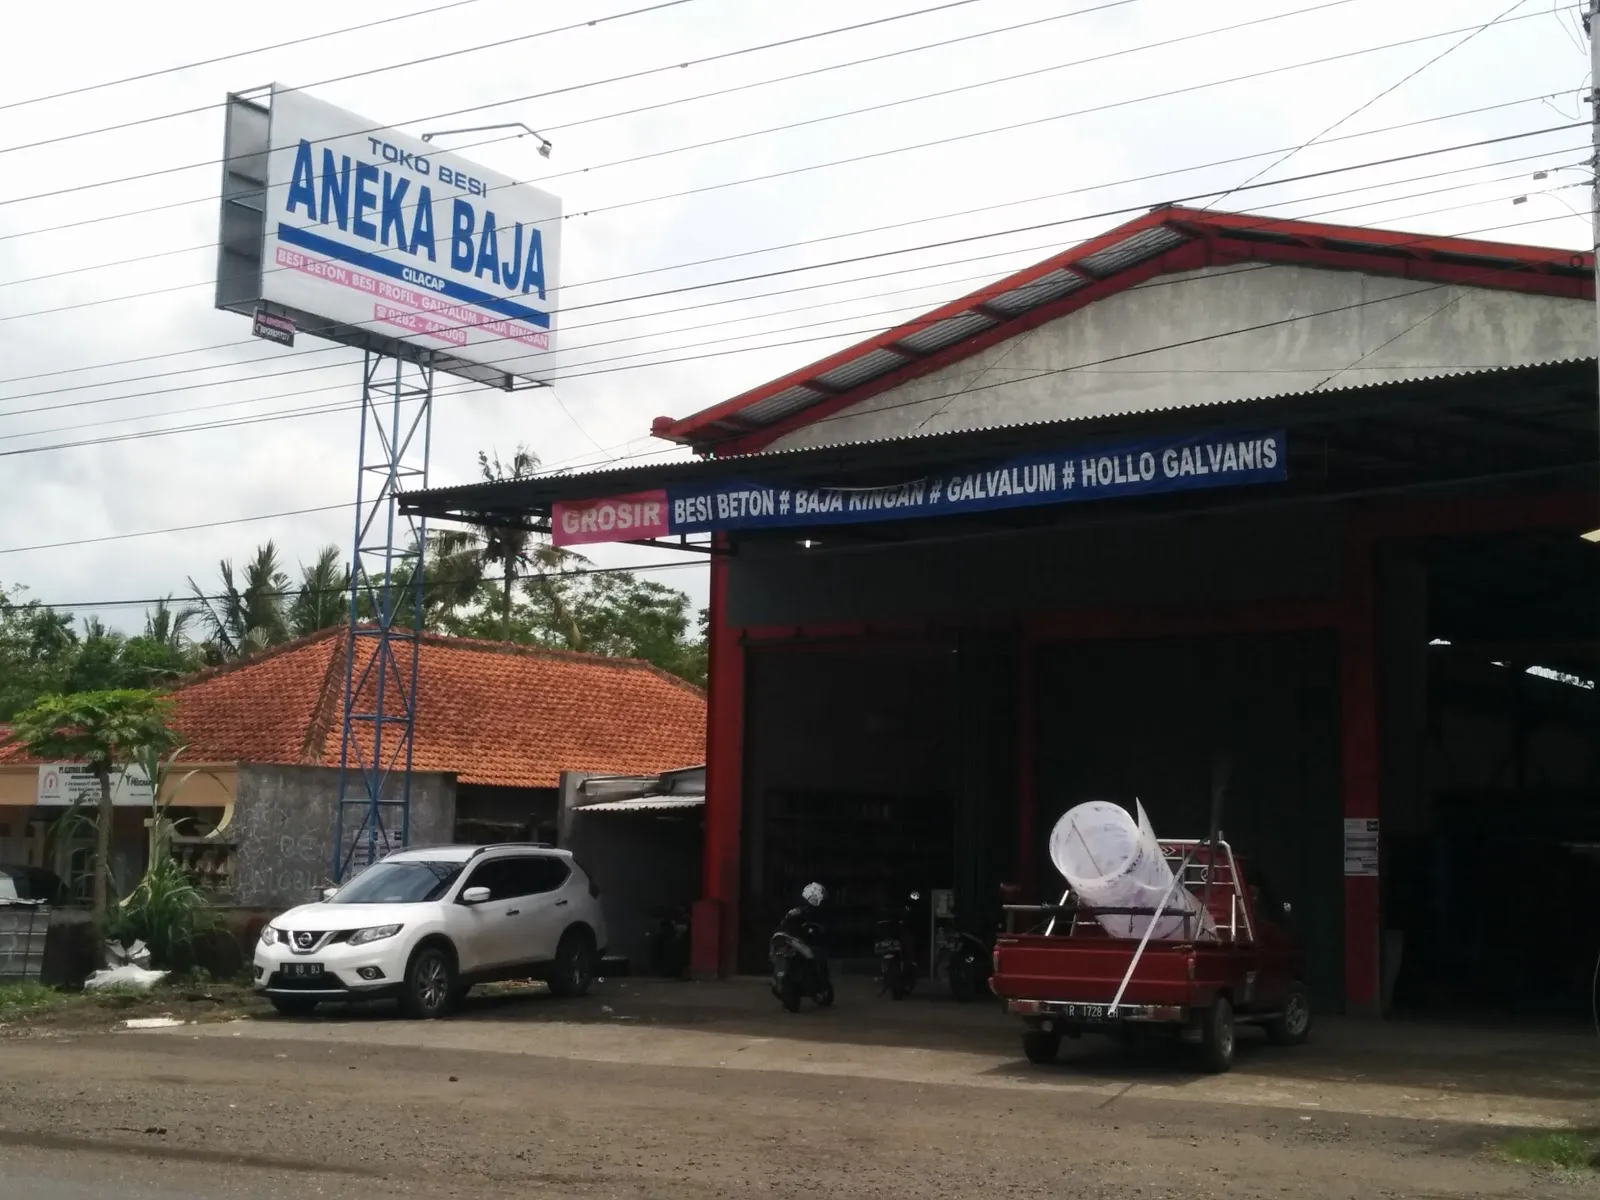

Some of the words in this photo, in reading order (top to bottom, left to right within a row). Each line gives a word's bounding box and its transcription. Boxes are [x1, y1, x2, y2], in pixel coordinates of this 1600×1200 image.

[368, 136, 430, 175] TOKO
[439, 158, 487, 198] BESI
[286, 138, 436, 262] ANEKA
[451, 198, 546, 300] BAJA
[278, 249, 303, 268] BESI
[352, 274, 376, 292] BESI
[509, 324, 548, 347] RINGAN
[402, 267, 446, 290] CILACAP
[561, 500, 662, 535] GROSIR
[674, 495, 713, 525] BESI
[717, 489, 775, 521] BETON
[795, 487, 843, 515] BAJA
[947, 462, 1056, 502] GALVALUM
[1081, 452, 1154, 487] HOLLO
[1163, 438, 1277, 478] GALVANIS
[1083, 1006, 1102, 1017] 1728
